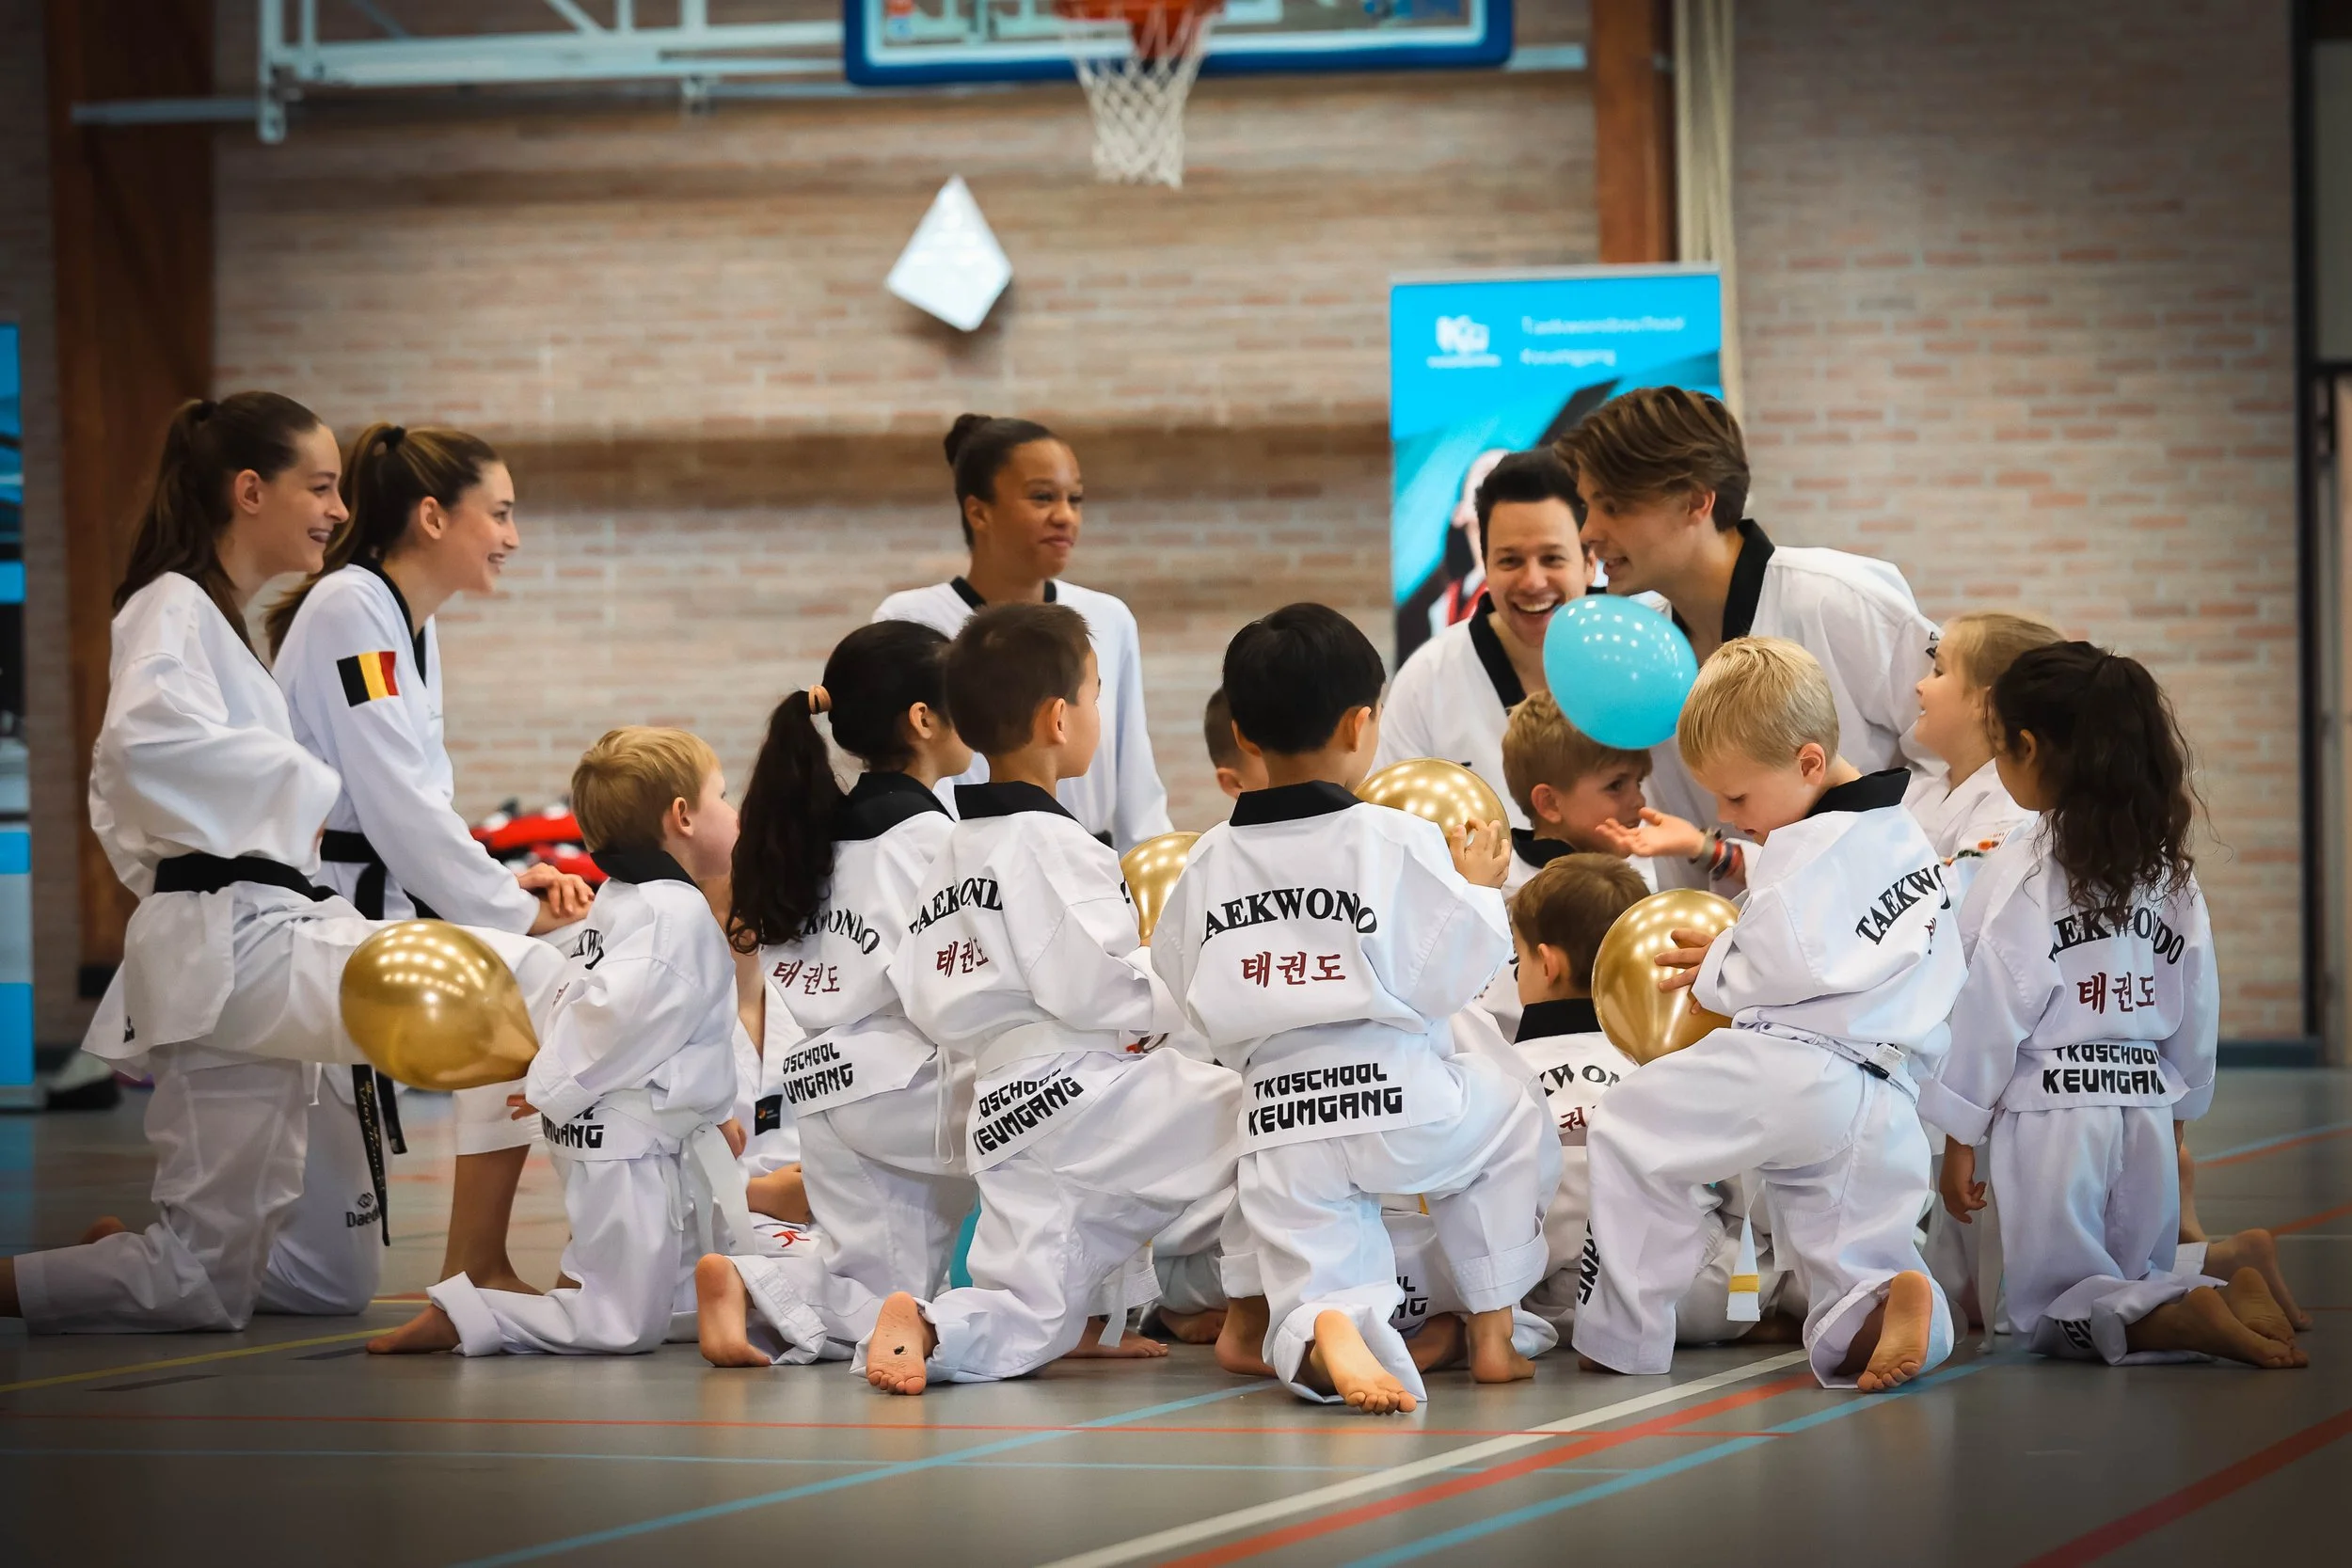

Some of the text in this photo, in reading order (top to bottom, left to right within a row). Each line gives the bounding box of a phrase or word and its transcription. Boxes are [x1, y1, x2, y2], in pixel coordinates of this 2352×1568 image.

[773, 959, 840, 995] 태권도
[1241, 951, 1345, 988] 태권도
[2076, 972, 2154, 1014] 태권도
[973, 1076, 1084, 1156] KEUMGANG
[1248, 1086, 1402, 1136] KEUMGANG
